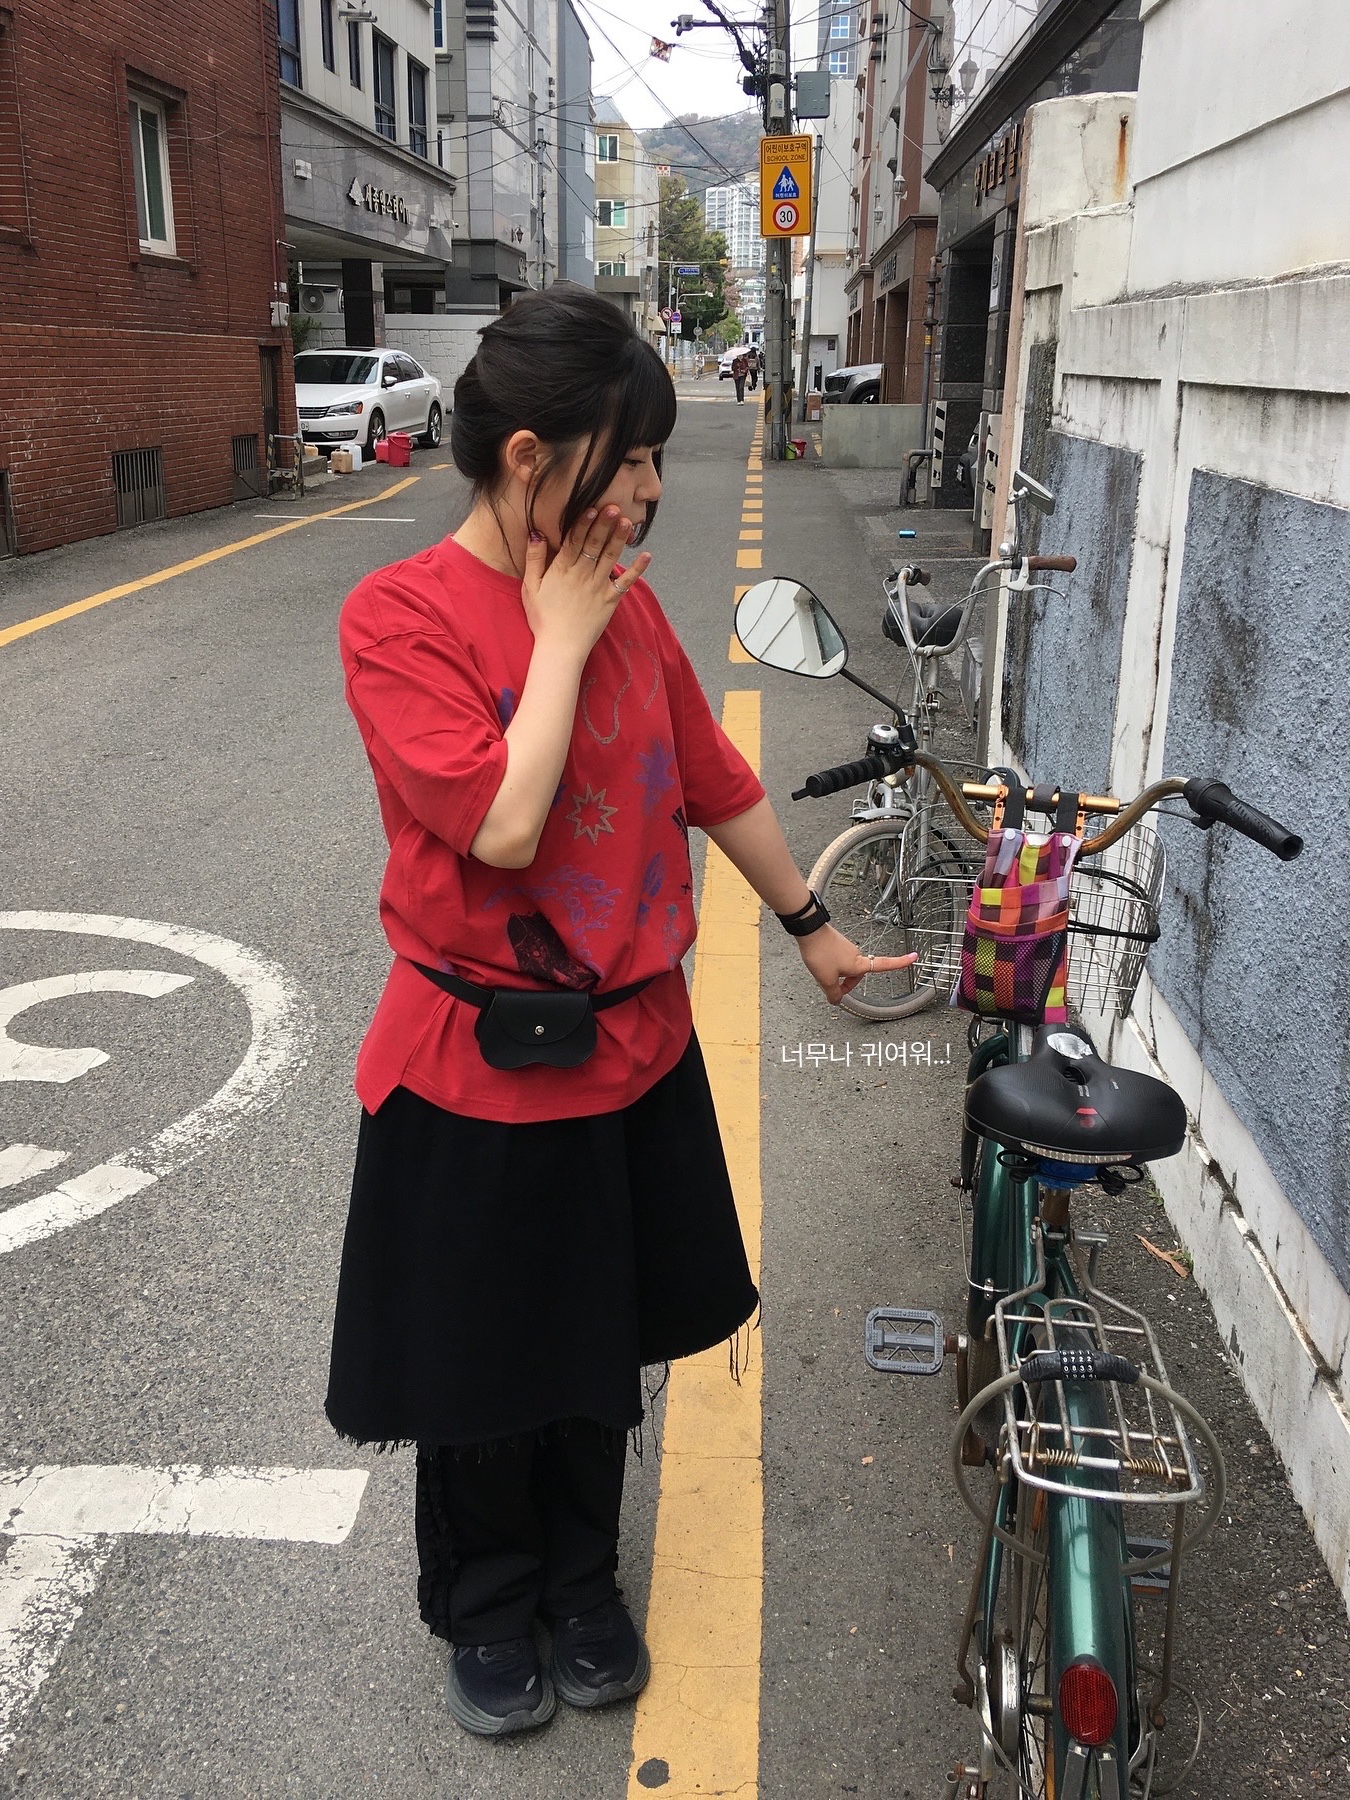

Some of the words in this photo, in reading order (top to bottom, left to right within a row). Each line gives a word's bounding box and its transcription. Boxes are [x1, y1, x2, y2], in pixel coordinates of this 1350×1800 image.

[765, 142, 807, 154] 어린이보호구역
[790, 153, 806, 161] ZONE
[779, 210, 793, 223] 30
